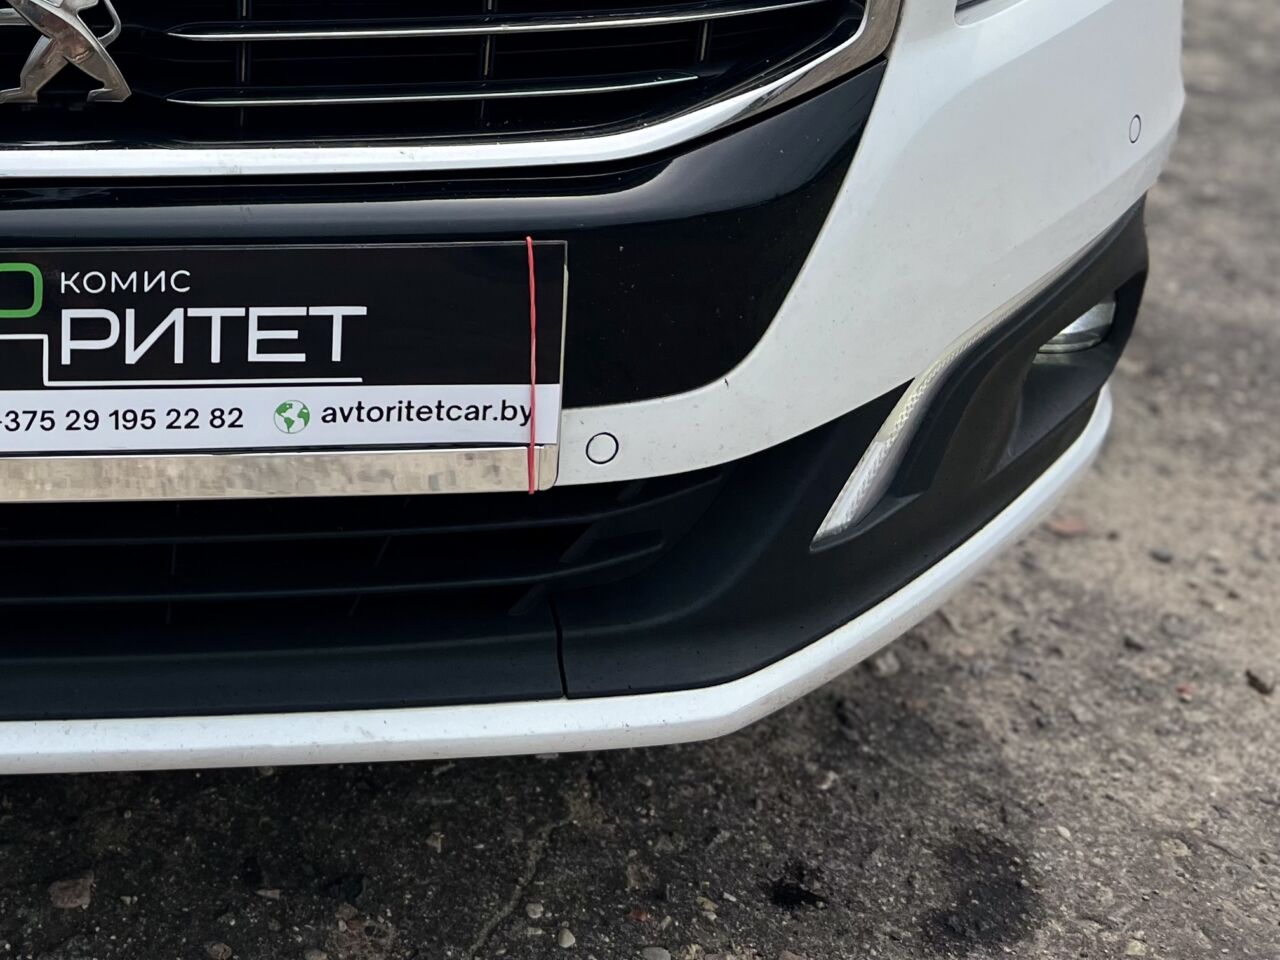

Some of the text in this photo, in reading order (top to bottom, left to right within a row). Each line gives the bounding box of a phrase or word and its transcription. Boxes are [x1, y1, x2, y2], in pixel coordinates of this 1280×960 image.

[60, 305, 368, 365] РИТЕТ
[65, 409, 100, 431] 29
[108, 408, 156, 430] 195
[165, 407, 200, 429] 22
[209, 407, 244, 429] 82
[320, 399, 532, 426] avtoritetcar.by
